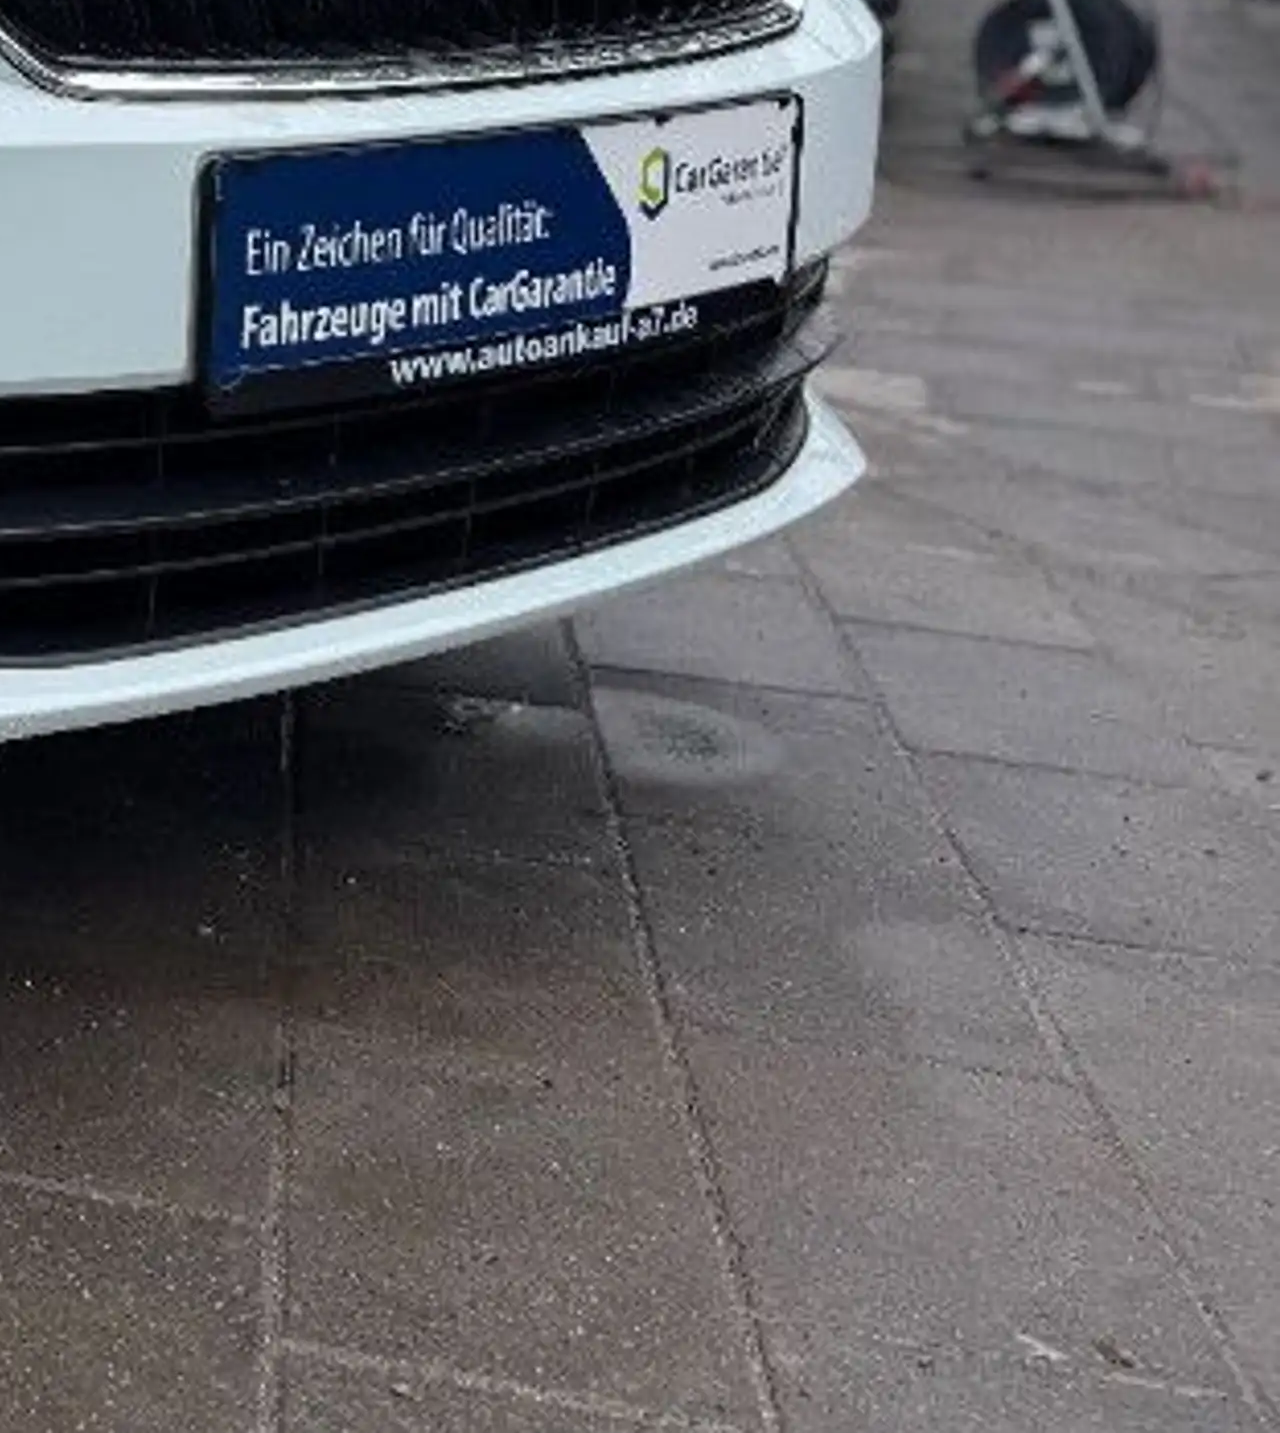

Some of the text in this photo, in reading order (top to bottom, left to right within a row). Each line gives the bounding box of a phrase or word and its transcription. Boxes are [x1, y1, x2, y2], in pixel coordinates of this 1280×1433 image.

[246, 228, 291, 276] Ein
[296, 219, 403, 272] Zeichen
[409, 211, 447, 256] für
[242, 256, 616, 350] Fahrzeuge mit CarGarantie
[391, 299, 699, 383] www.autoankauf-a7.de
